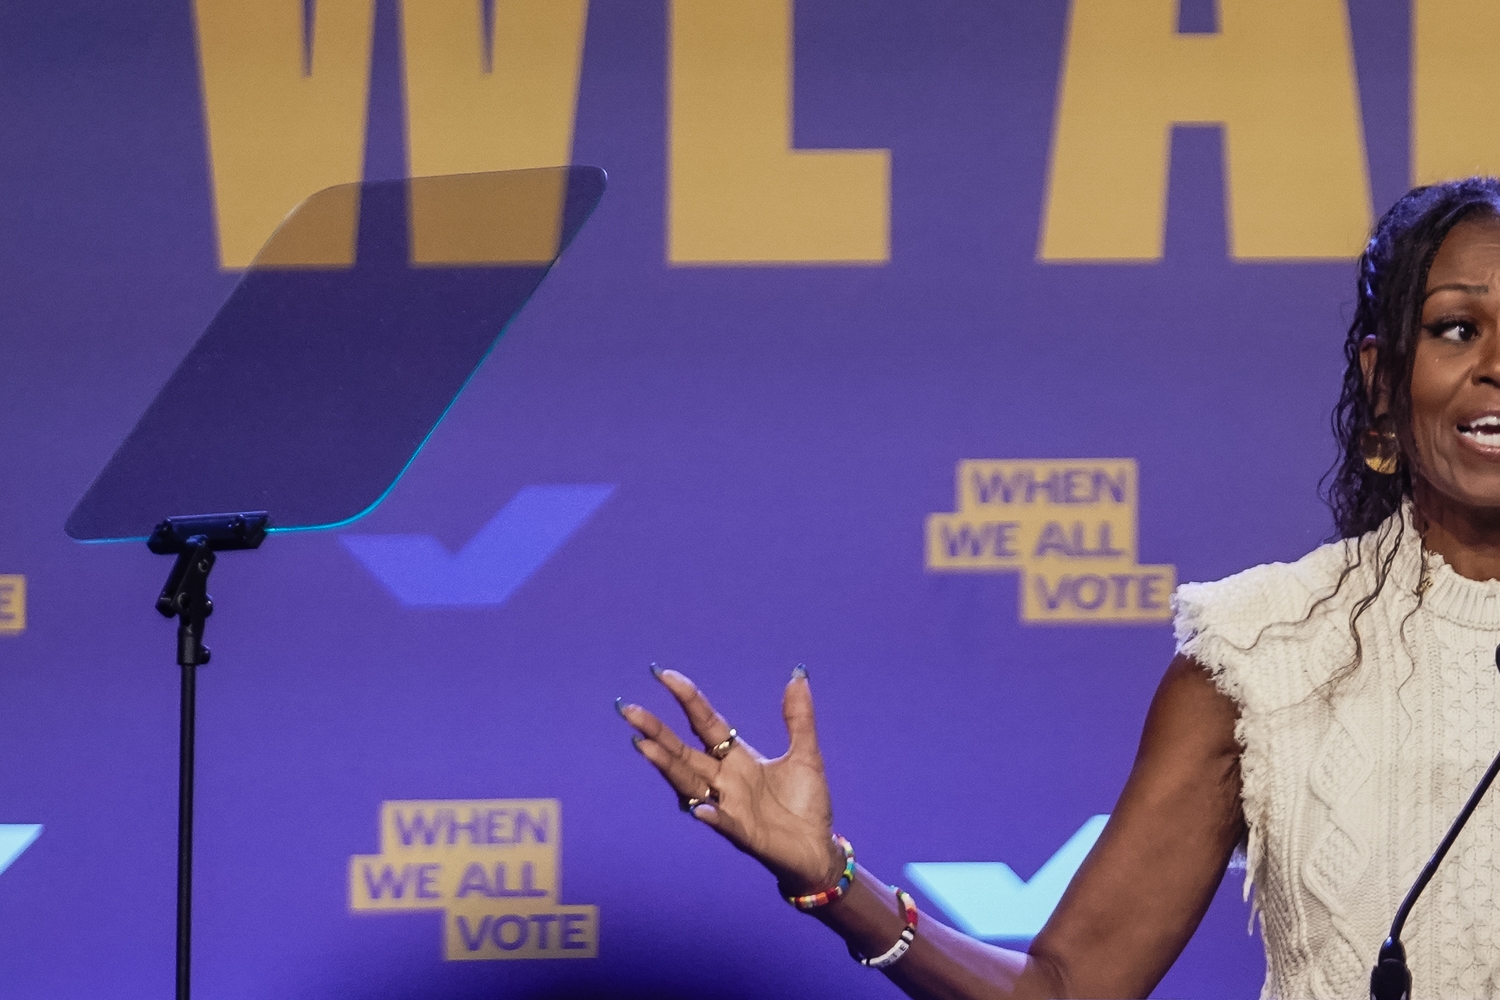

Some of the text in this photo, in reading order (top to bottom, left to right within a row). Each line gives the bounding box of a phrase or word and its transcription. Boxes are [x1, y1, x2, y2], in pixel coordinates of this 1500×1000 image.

[970, 467, 1128, 503] WHEN
[940, 519, 1128, 558] WE ALL
[1034, 572, 1164, 610] VOTE
[393, 806, 548, 846] WHEN
[363, 860, 549, 900] WE ALL
[456, 913, 588, 951] VOTE
